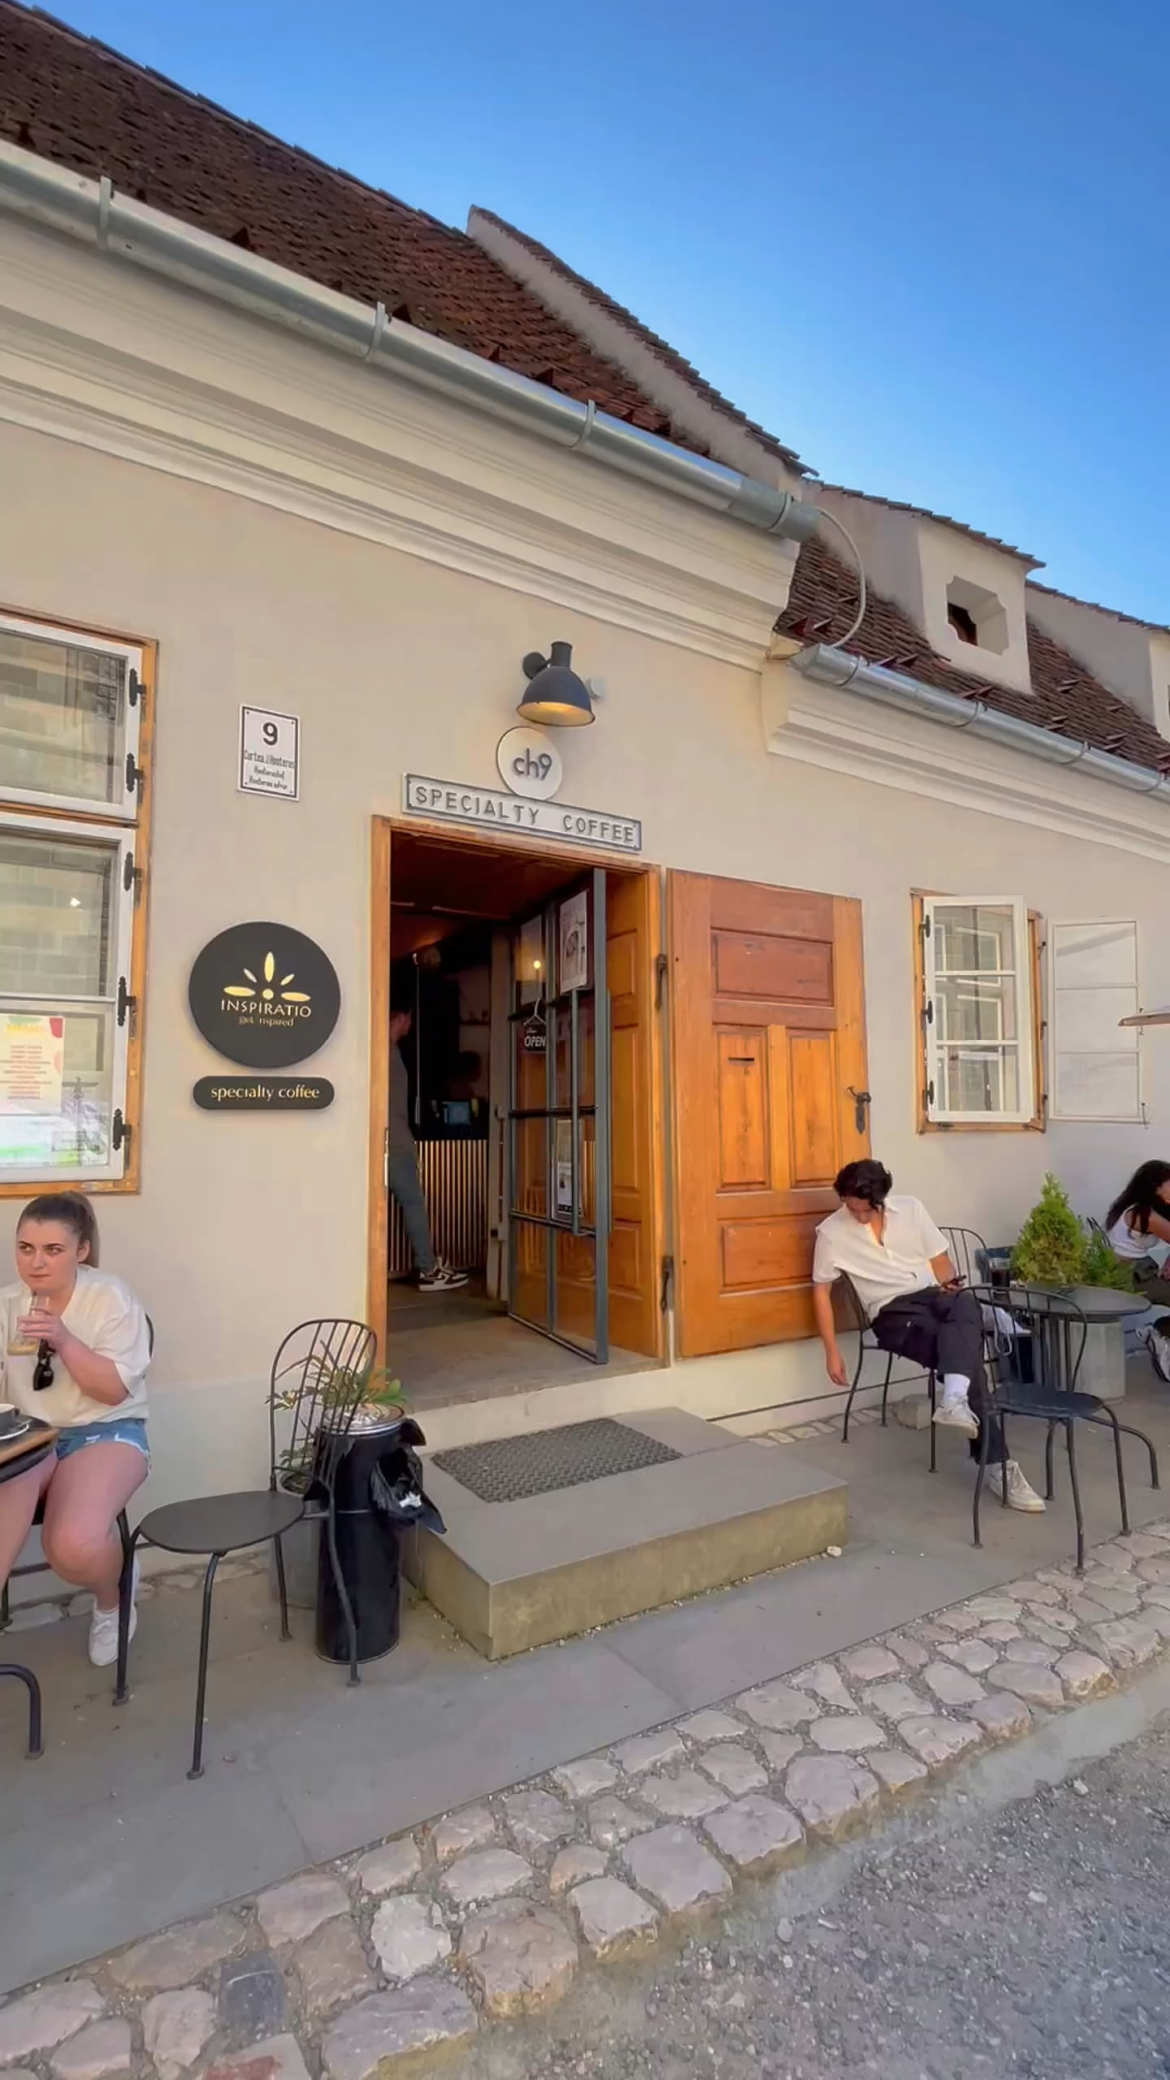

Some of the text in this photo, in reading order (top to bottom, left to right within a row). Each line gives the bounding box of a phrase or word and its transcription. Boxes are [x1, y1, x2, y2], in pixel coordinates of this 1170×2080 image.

[262, 722, 278, 746] 9
[513, 748, 553, 781] ch9
[415, 786, 634, 843] SPECIALTY COFFEE
[221, 999, 311, 1018] INSPIRATIO
[524, 1036, 547, 1047] OPEN
[211, 1084, 320, 1102] specialty coffee
